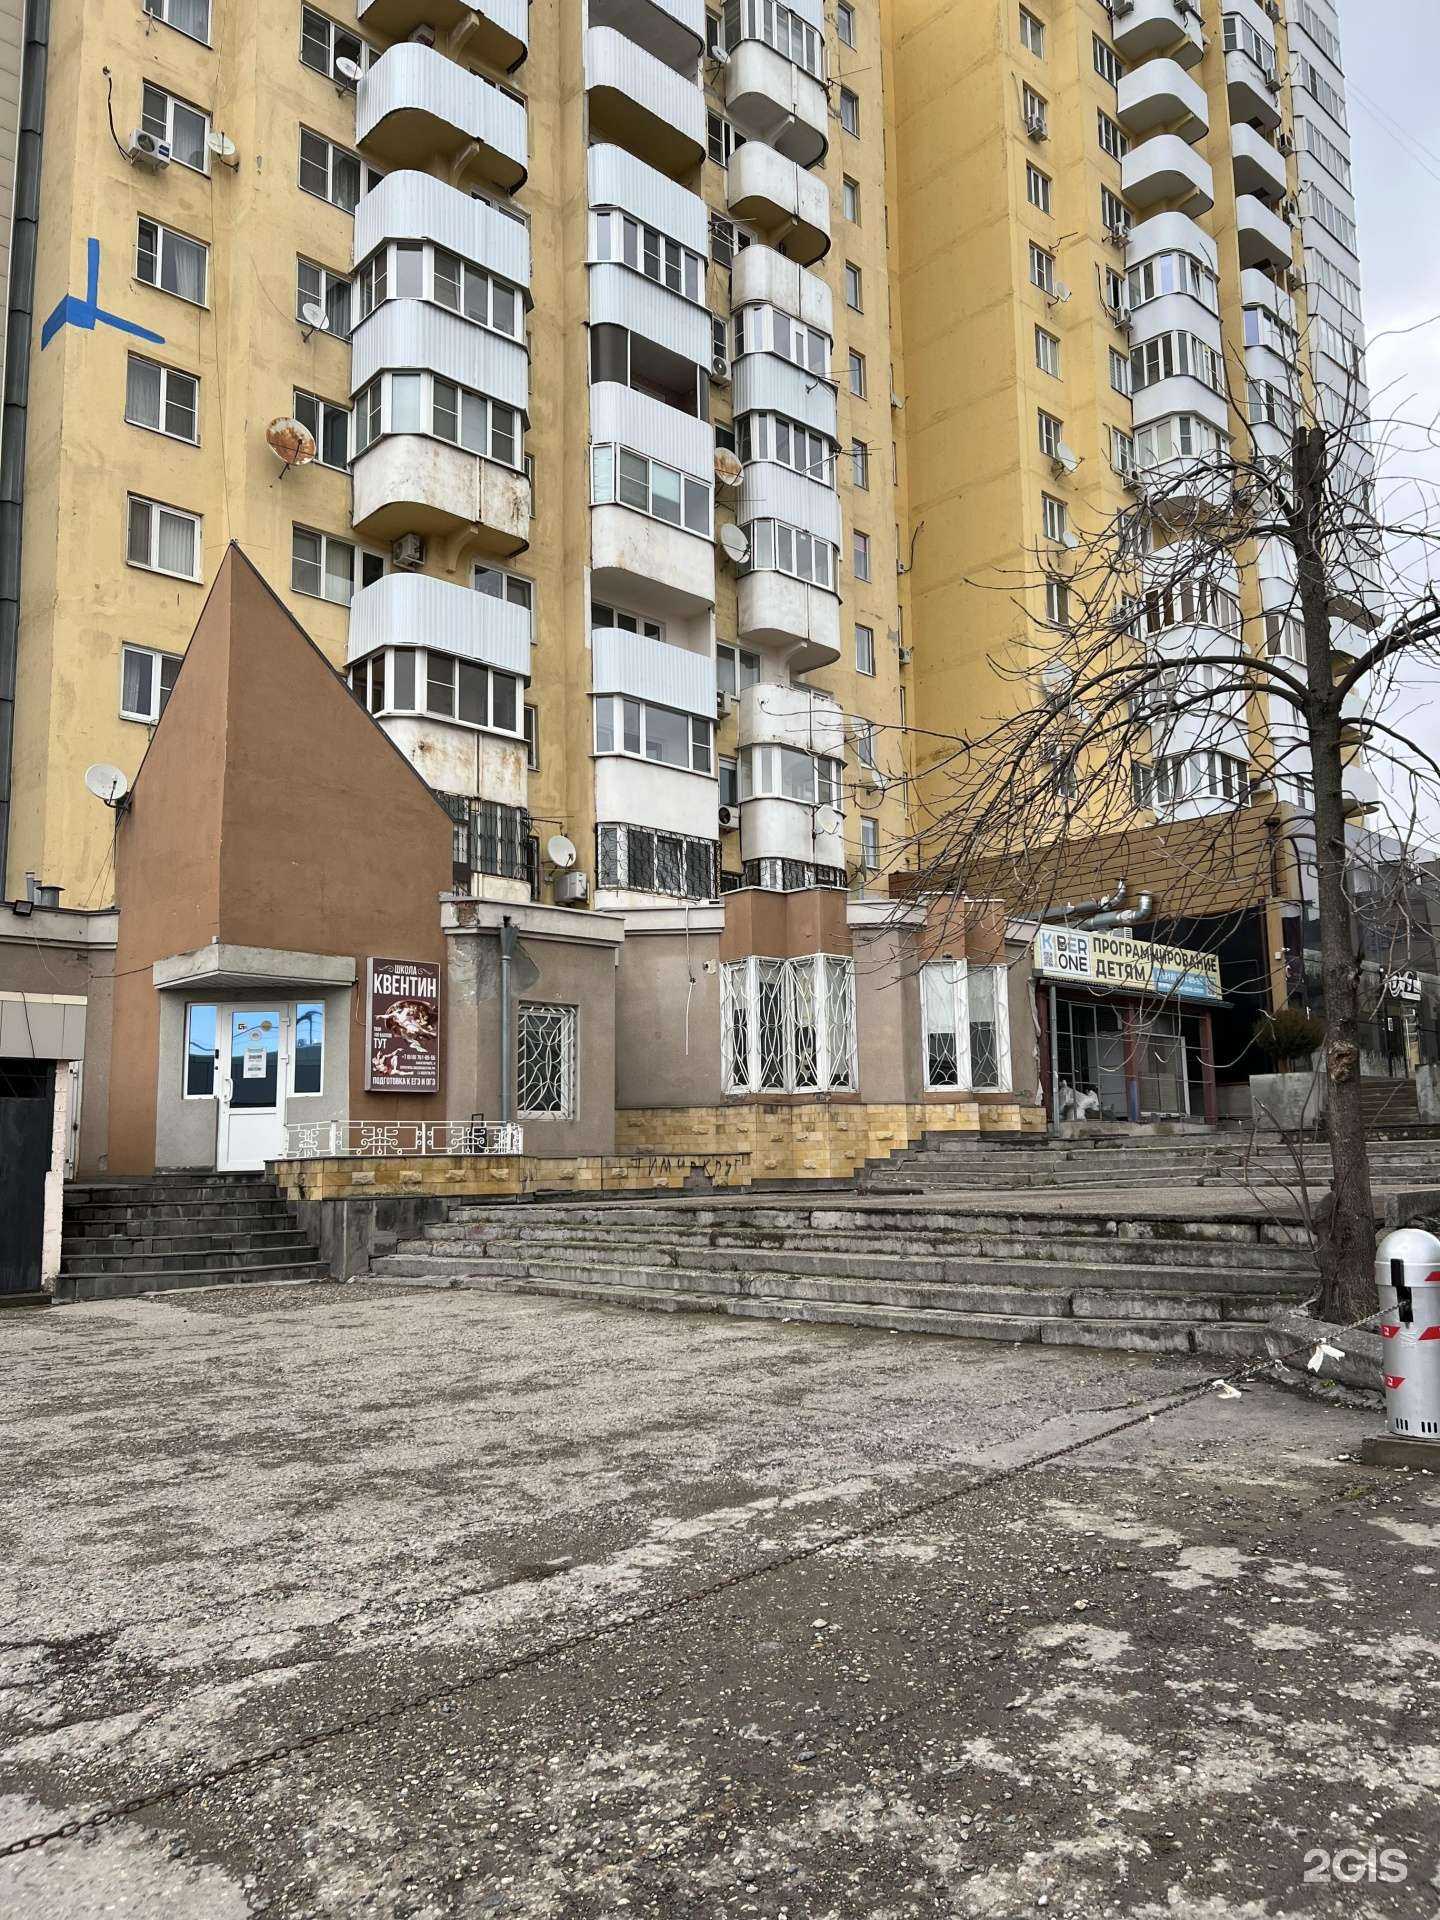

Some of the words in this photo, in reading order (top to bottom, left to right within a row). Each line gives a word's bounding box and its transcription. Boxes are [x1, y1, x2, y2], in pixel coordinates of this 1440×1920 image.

[394, 964, 418, 976] ШКОЛА
[1058, 953, 1088, 972] ONE
[1096, 958, 1146, 981] ДЕТЯМ
[373, 973, 437, 998] КВЕНТИН
[373, 1037, 388, 1049] ТУТ
